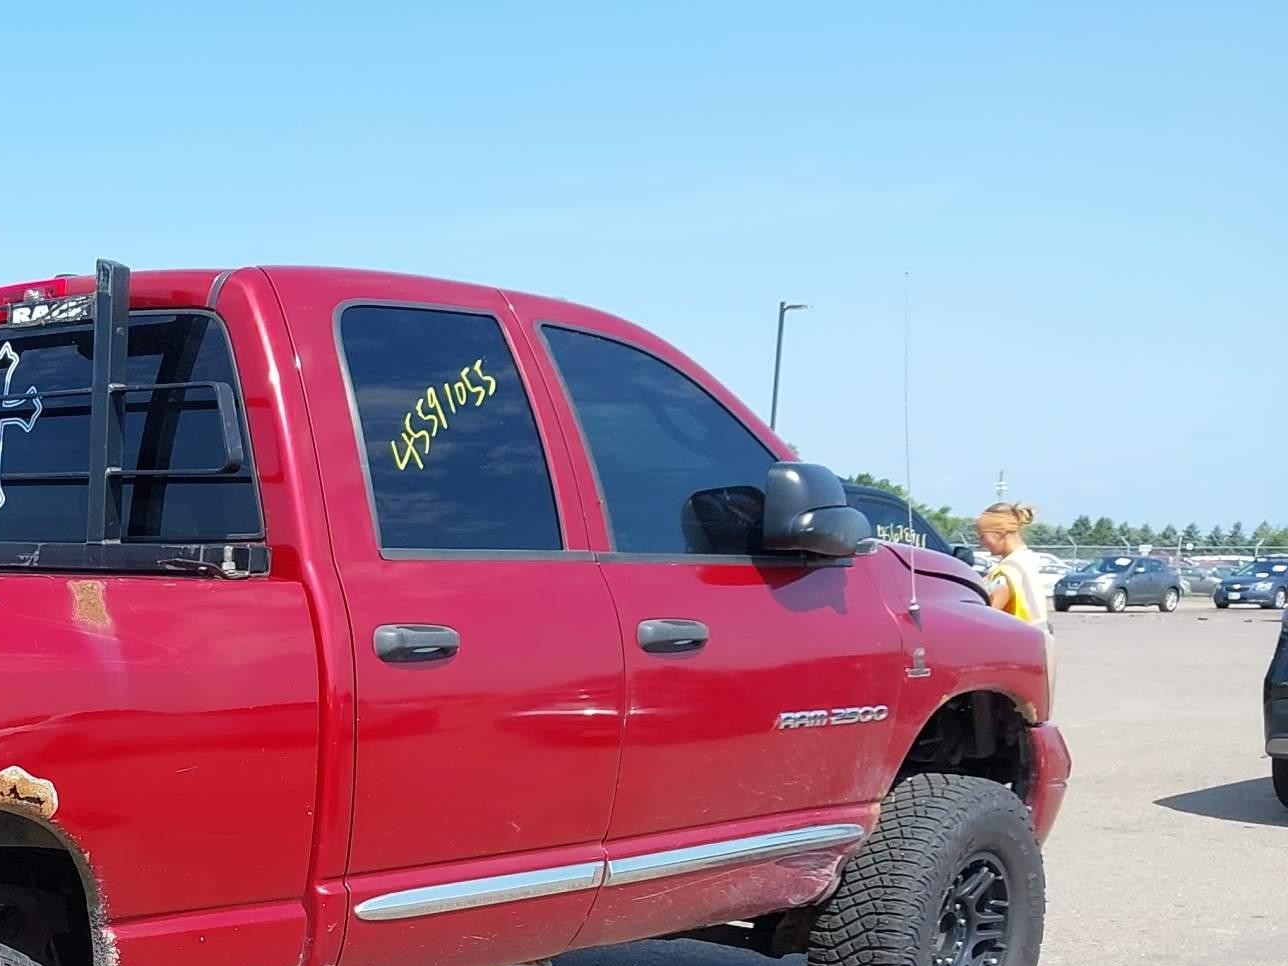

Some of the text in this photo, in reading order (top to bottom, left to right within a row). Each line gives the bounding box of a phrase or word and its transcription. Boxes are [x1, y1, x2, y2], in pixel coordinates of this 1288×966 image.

[391, 359, 496, 470] 45591055
[778, 705, 889, 729] RAM 2500
